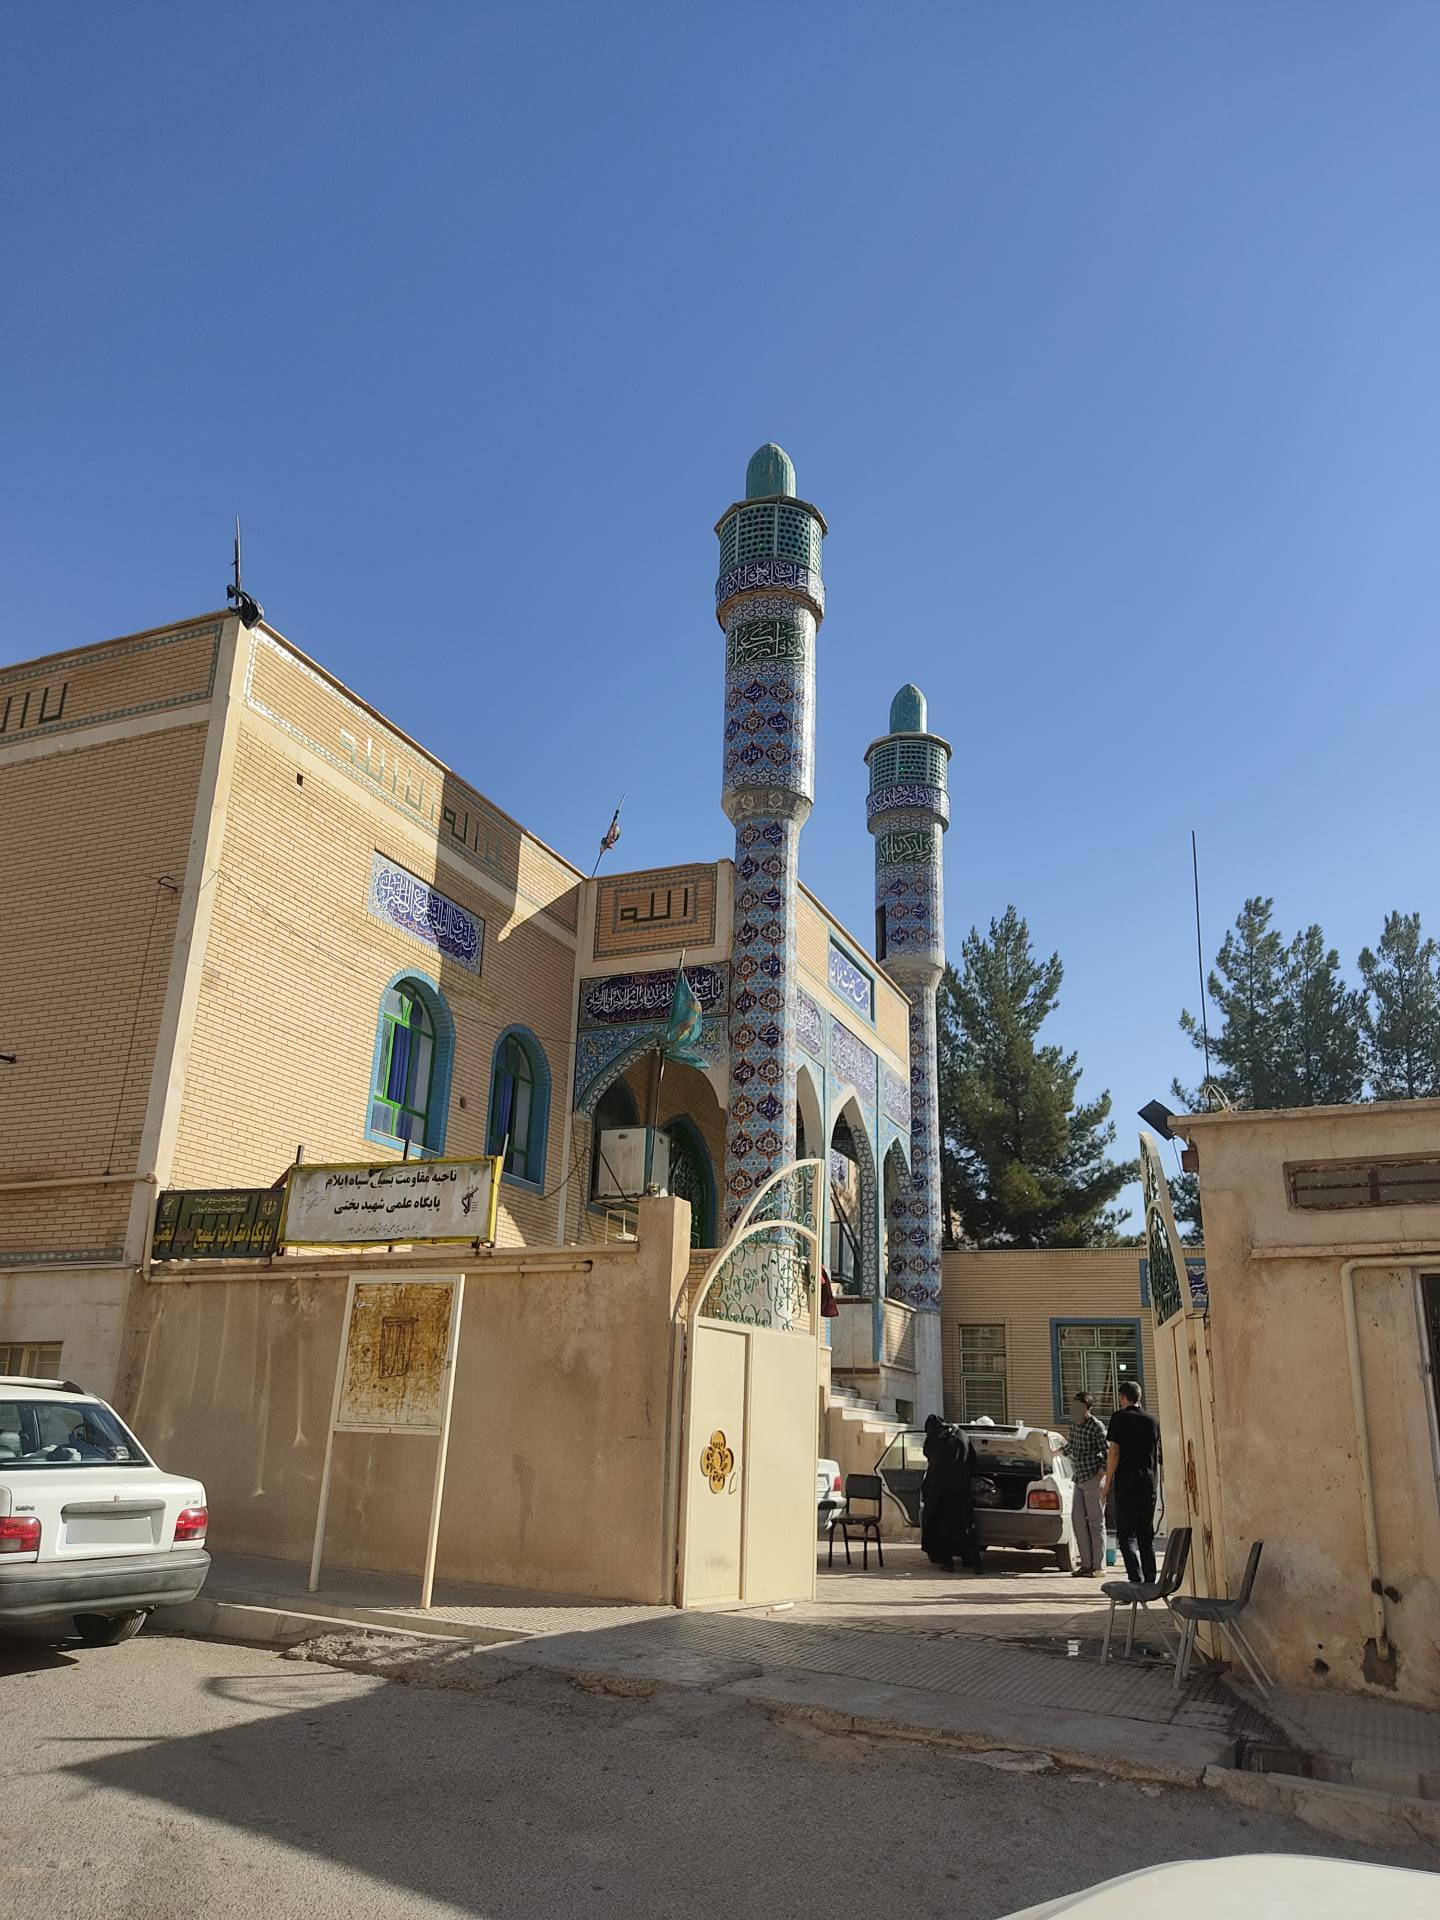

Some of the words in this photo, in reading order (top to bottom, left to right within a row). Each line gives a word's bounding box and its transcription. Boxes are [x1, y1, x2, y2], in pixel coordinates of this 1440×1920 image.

[620, 888, 689, 923] الله
[325, 1174, 348, 1191] ایلام
[349, 1174, 369, 1190] سپاه
[395, 1171, 430, 1187] مقاومت
[432, 1169, 457, 1186] ناحیه
[333, 1198, 360, 1215] بختی
[361, 1198, 385, 1213] شهید
[385, 1196, 413, 1214] علمی
[413, 1195, 441, 1212] پایگاه
